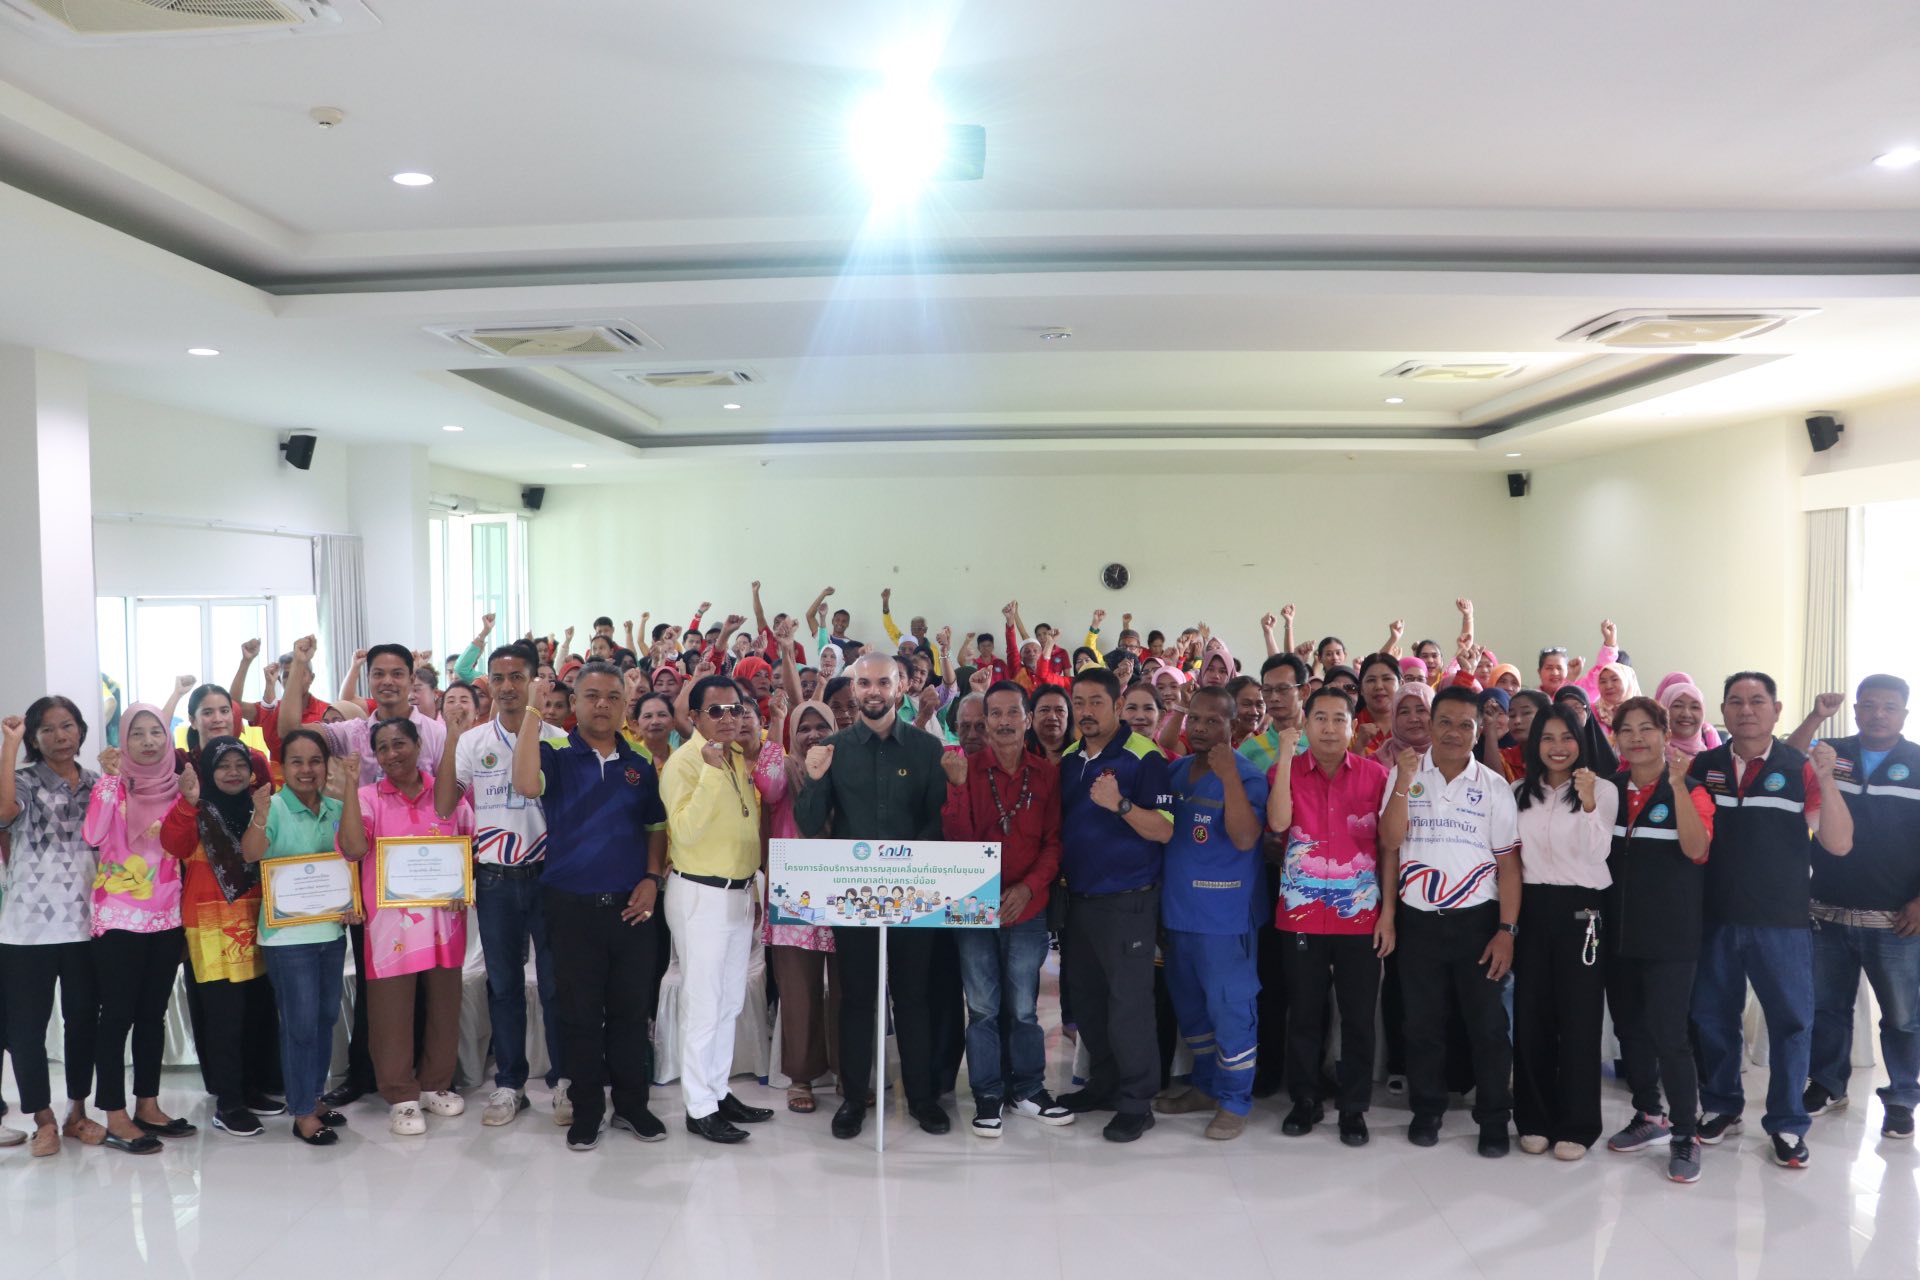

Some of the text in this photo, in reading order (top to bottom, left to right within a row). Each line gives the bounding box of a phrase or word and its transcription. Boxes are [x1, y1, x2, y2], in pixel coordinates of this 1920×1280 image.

[1194, 813, 1212, 824] EMR
[784, 863, 985, 876] โครงการจัดบริการสาธารณสุขเคลื่อนที่เชิงรุกในชุมชน
[833, 874, 937, 885] เขตเทศบาลตำบลกระบี่น้อย
